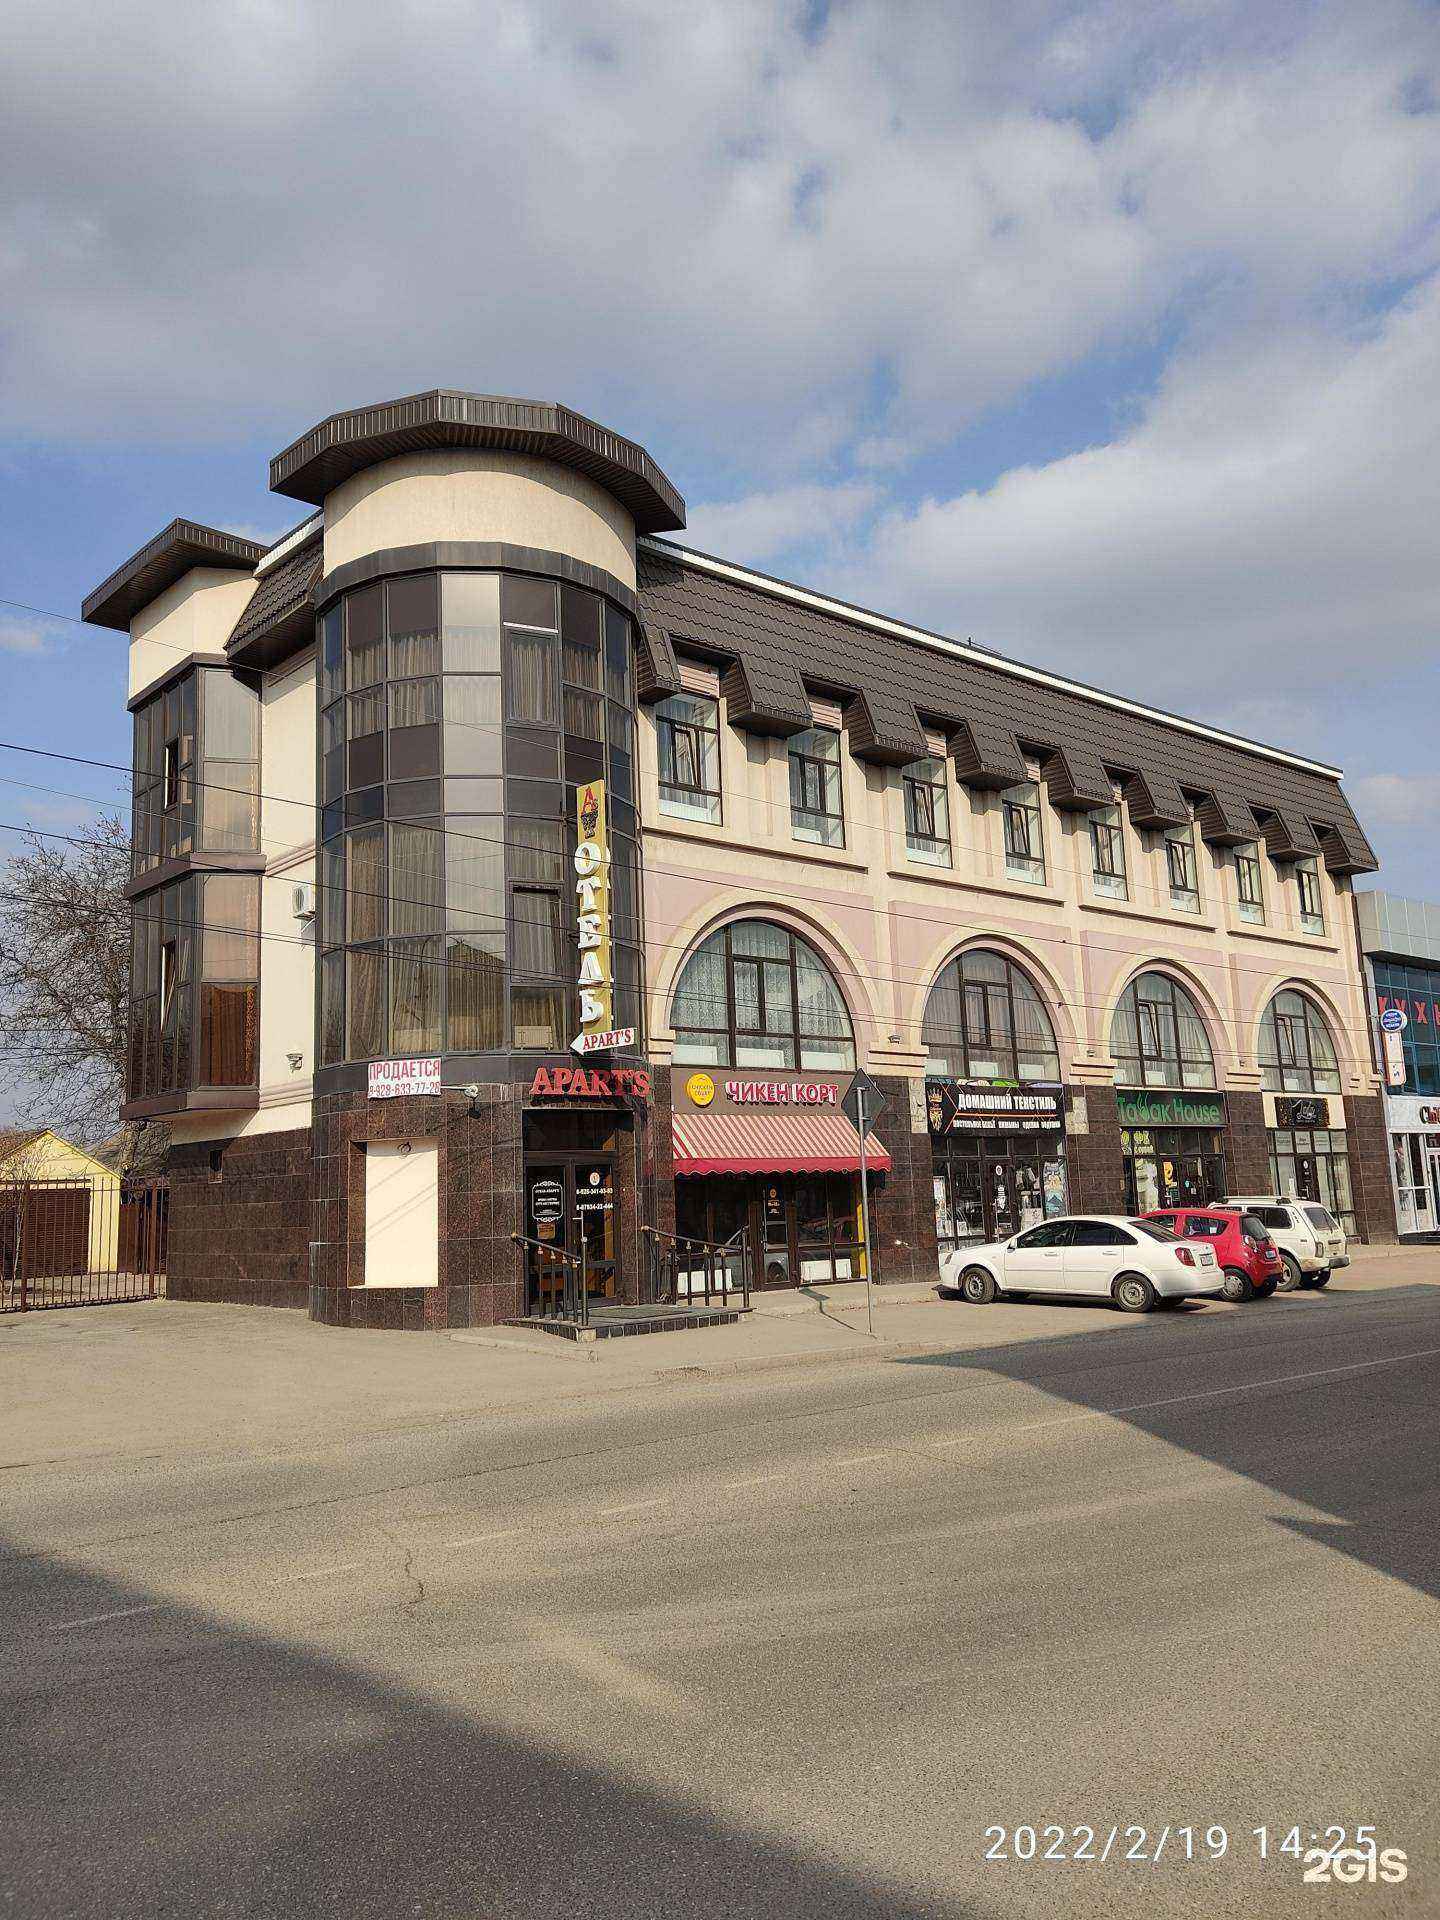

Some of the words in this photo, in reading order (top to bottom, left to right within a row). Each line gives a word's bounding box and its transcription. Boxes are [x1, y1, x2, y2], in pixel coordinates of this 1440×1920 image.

[574, 842, 604, 1023] ОТЕЛЬ
[582, 1029, 632, 1050] APART'S
[369, 1060, 440, 1081] ПРОДАЕТСЯ
[528, 1067, 651, 1098] APART'S
[726, 1081, 789, 1103] ЧИКЕН
[795, 1082, 839, 1104] КОРТ
[958, 1093, 1012, 1110] ДОМАШНИЙ
[1013, 1095, 1057, 1110] ТЕКСТИЛЬ
[1173, 1097, 1220, 1122] House
